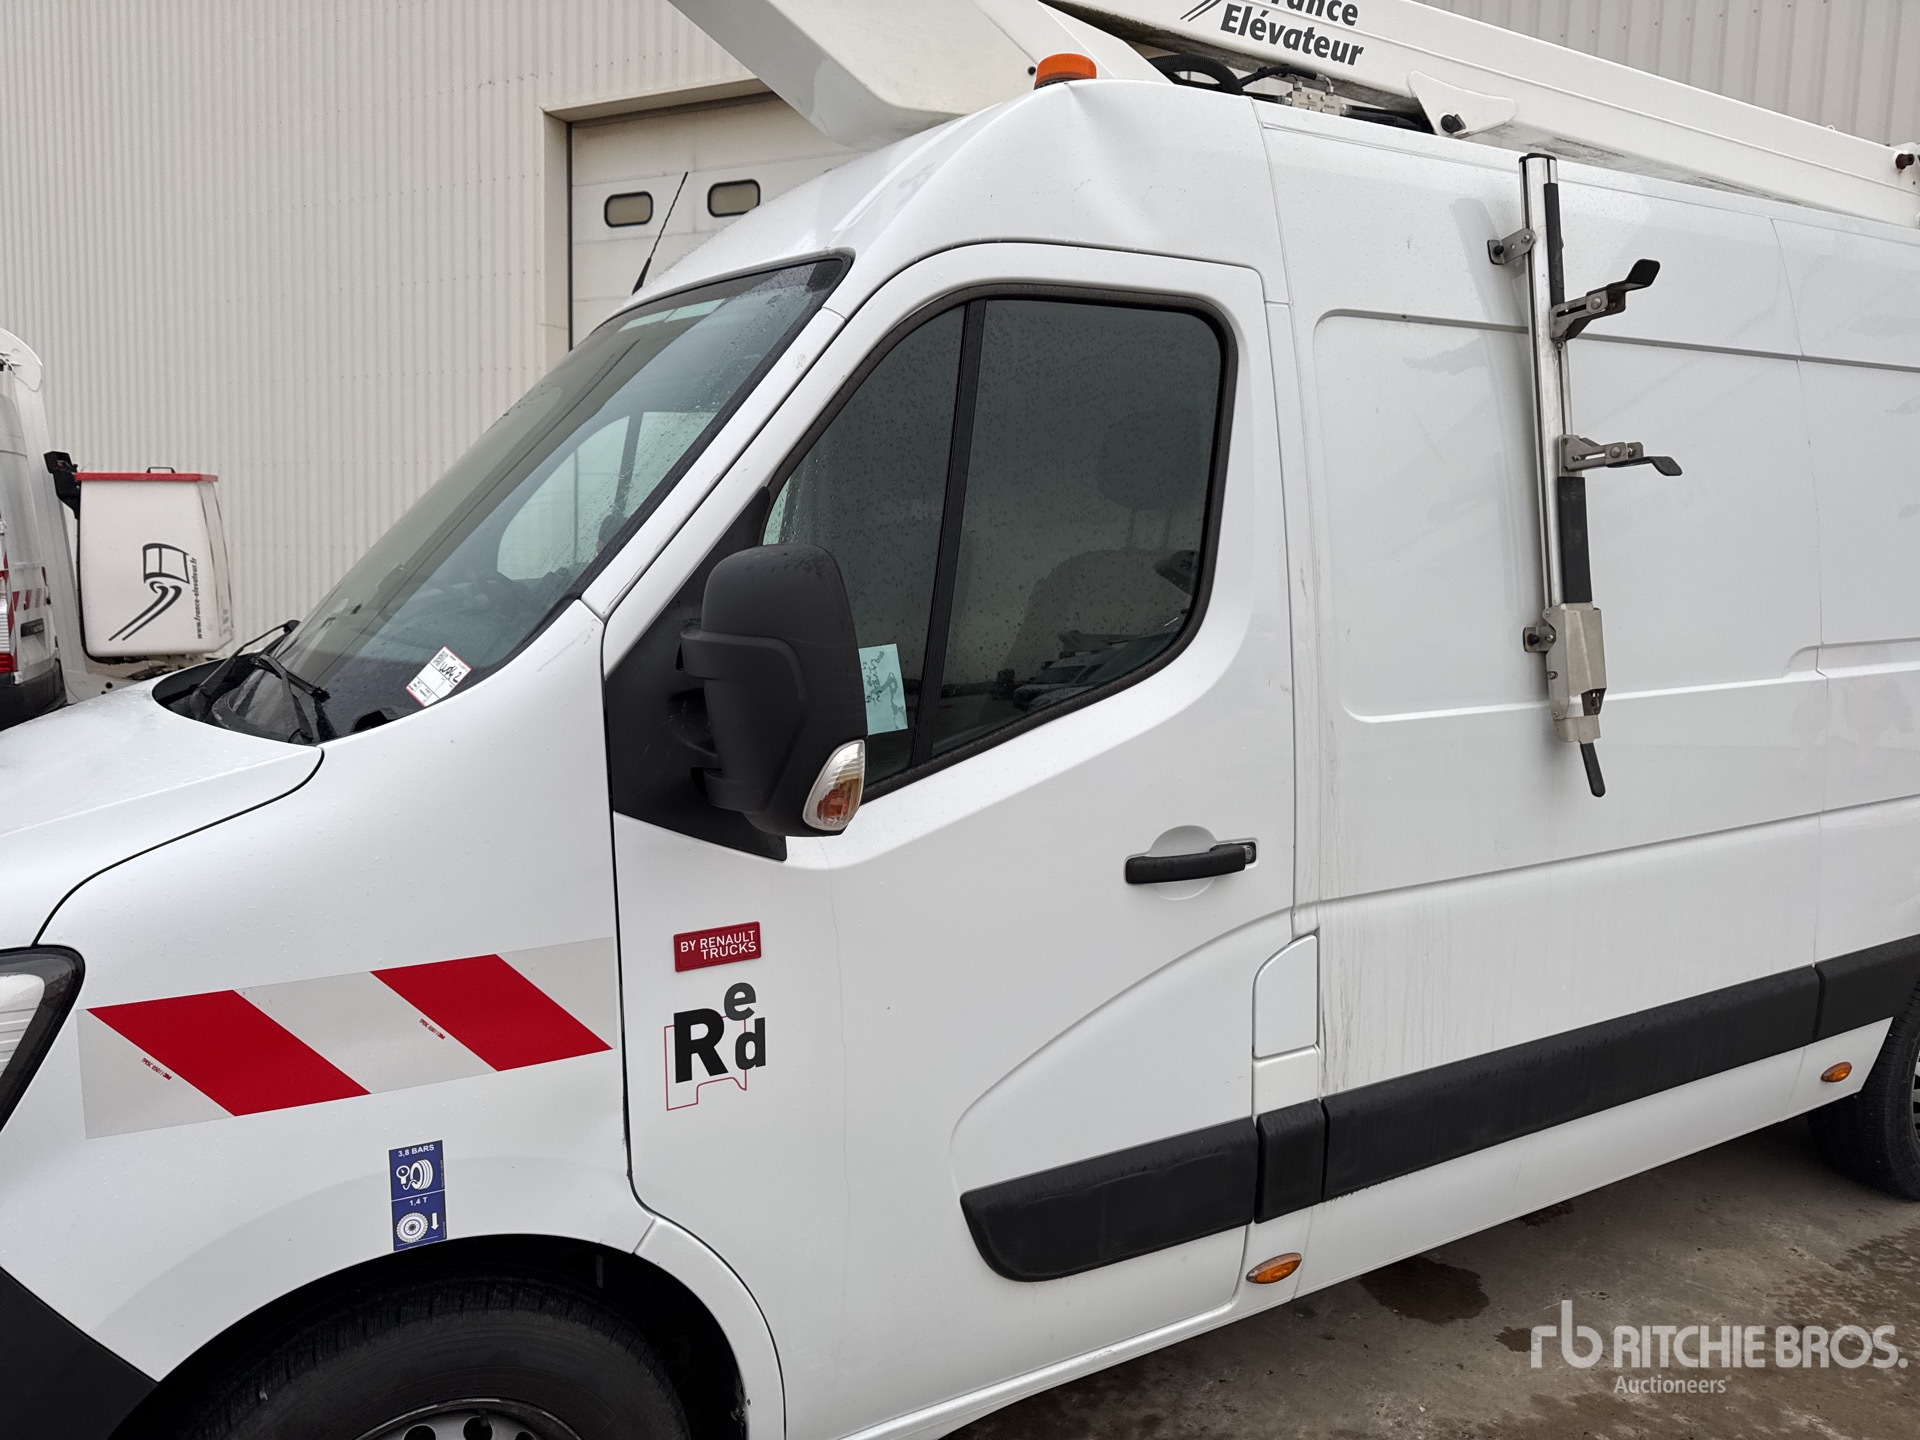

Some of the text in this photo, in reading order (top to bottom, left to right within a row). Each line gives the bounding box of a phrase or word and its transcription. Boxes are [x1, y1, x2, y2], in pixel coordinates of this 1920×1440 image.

[1271, 0, 1358, 26] ance
[1220, 3, 1364, 66] Elévateur
[190, 557, 203, 640] www.france-elevateur.fr
[680, 930, 755, 953] BY RENAULT
[700, 941, 757, 960] TRUCKS
[398, 1144, 435, 1157] 3,8 BARS
[409, 1198, 421, 1206] 1,4
